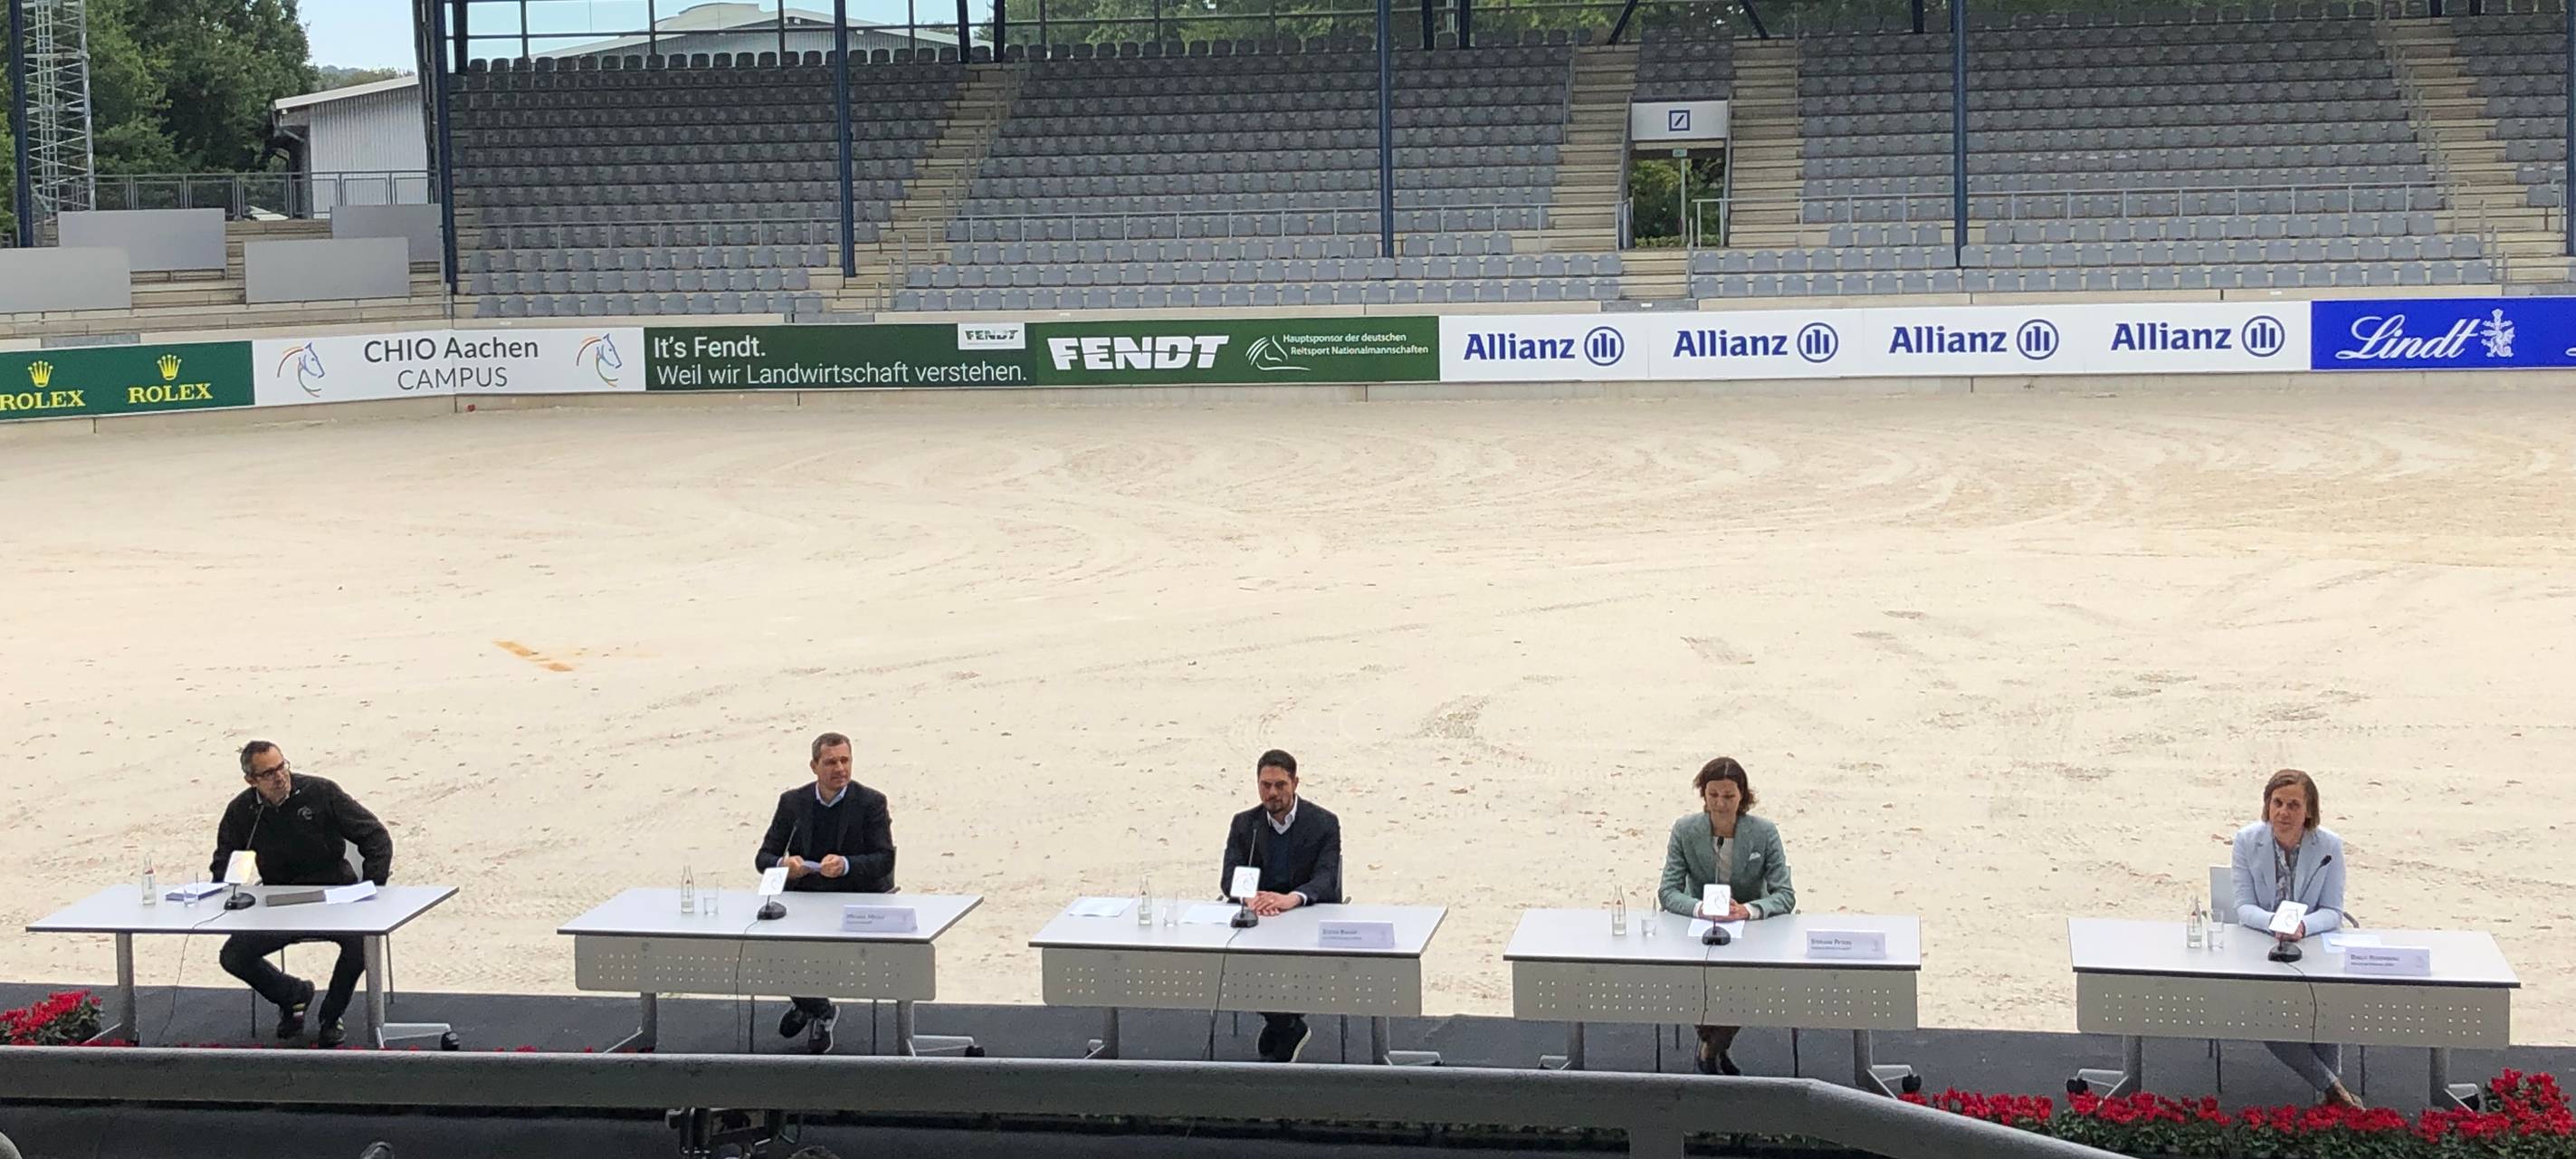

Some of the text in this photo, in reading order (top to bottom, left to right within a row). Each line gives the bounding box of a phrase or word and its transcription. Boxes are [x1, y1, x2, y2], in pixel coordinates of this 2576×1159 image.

[655, 335, 765, 358] It's Fendt.
[1283, 333, 1406, 344] Hauptsponsor der deutschen
[1465, 333, 1575, 359] Allianz
[1674, 330, 1788, 357] Allianz
[1889, 326, 2007, 353] Allianz
[2112, 322, 2231, 350] Allianz
[2335, 315, 2480, 359] Lindt
[365, 337, 538, 362] CHIO Aachen
[1047, 336, 1229, 369] FENDT
[1291, 345, 1428, 356] Reitsport Nationalmannschaften
[398, 367, 507, 389] CAMPUS
[657, 361, 1026, 384] Weil wir Landwirtschaft verstehen.
[0, 390, 85, 410] ROLEX
[129, 384, 213, 403] ROLEX
